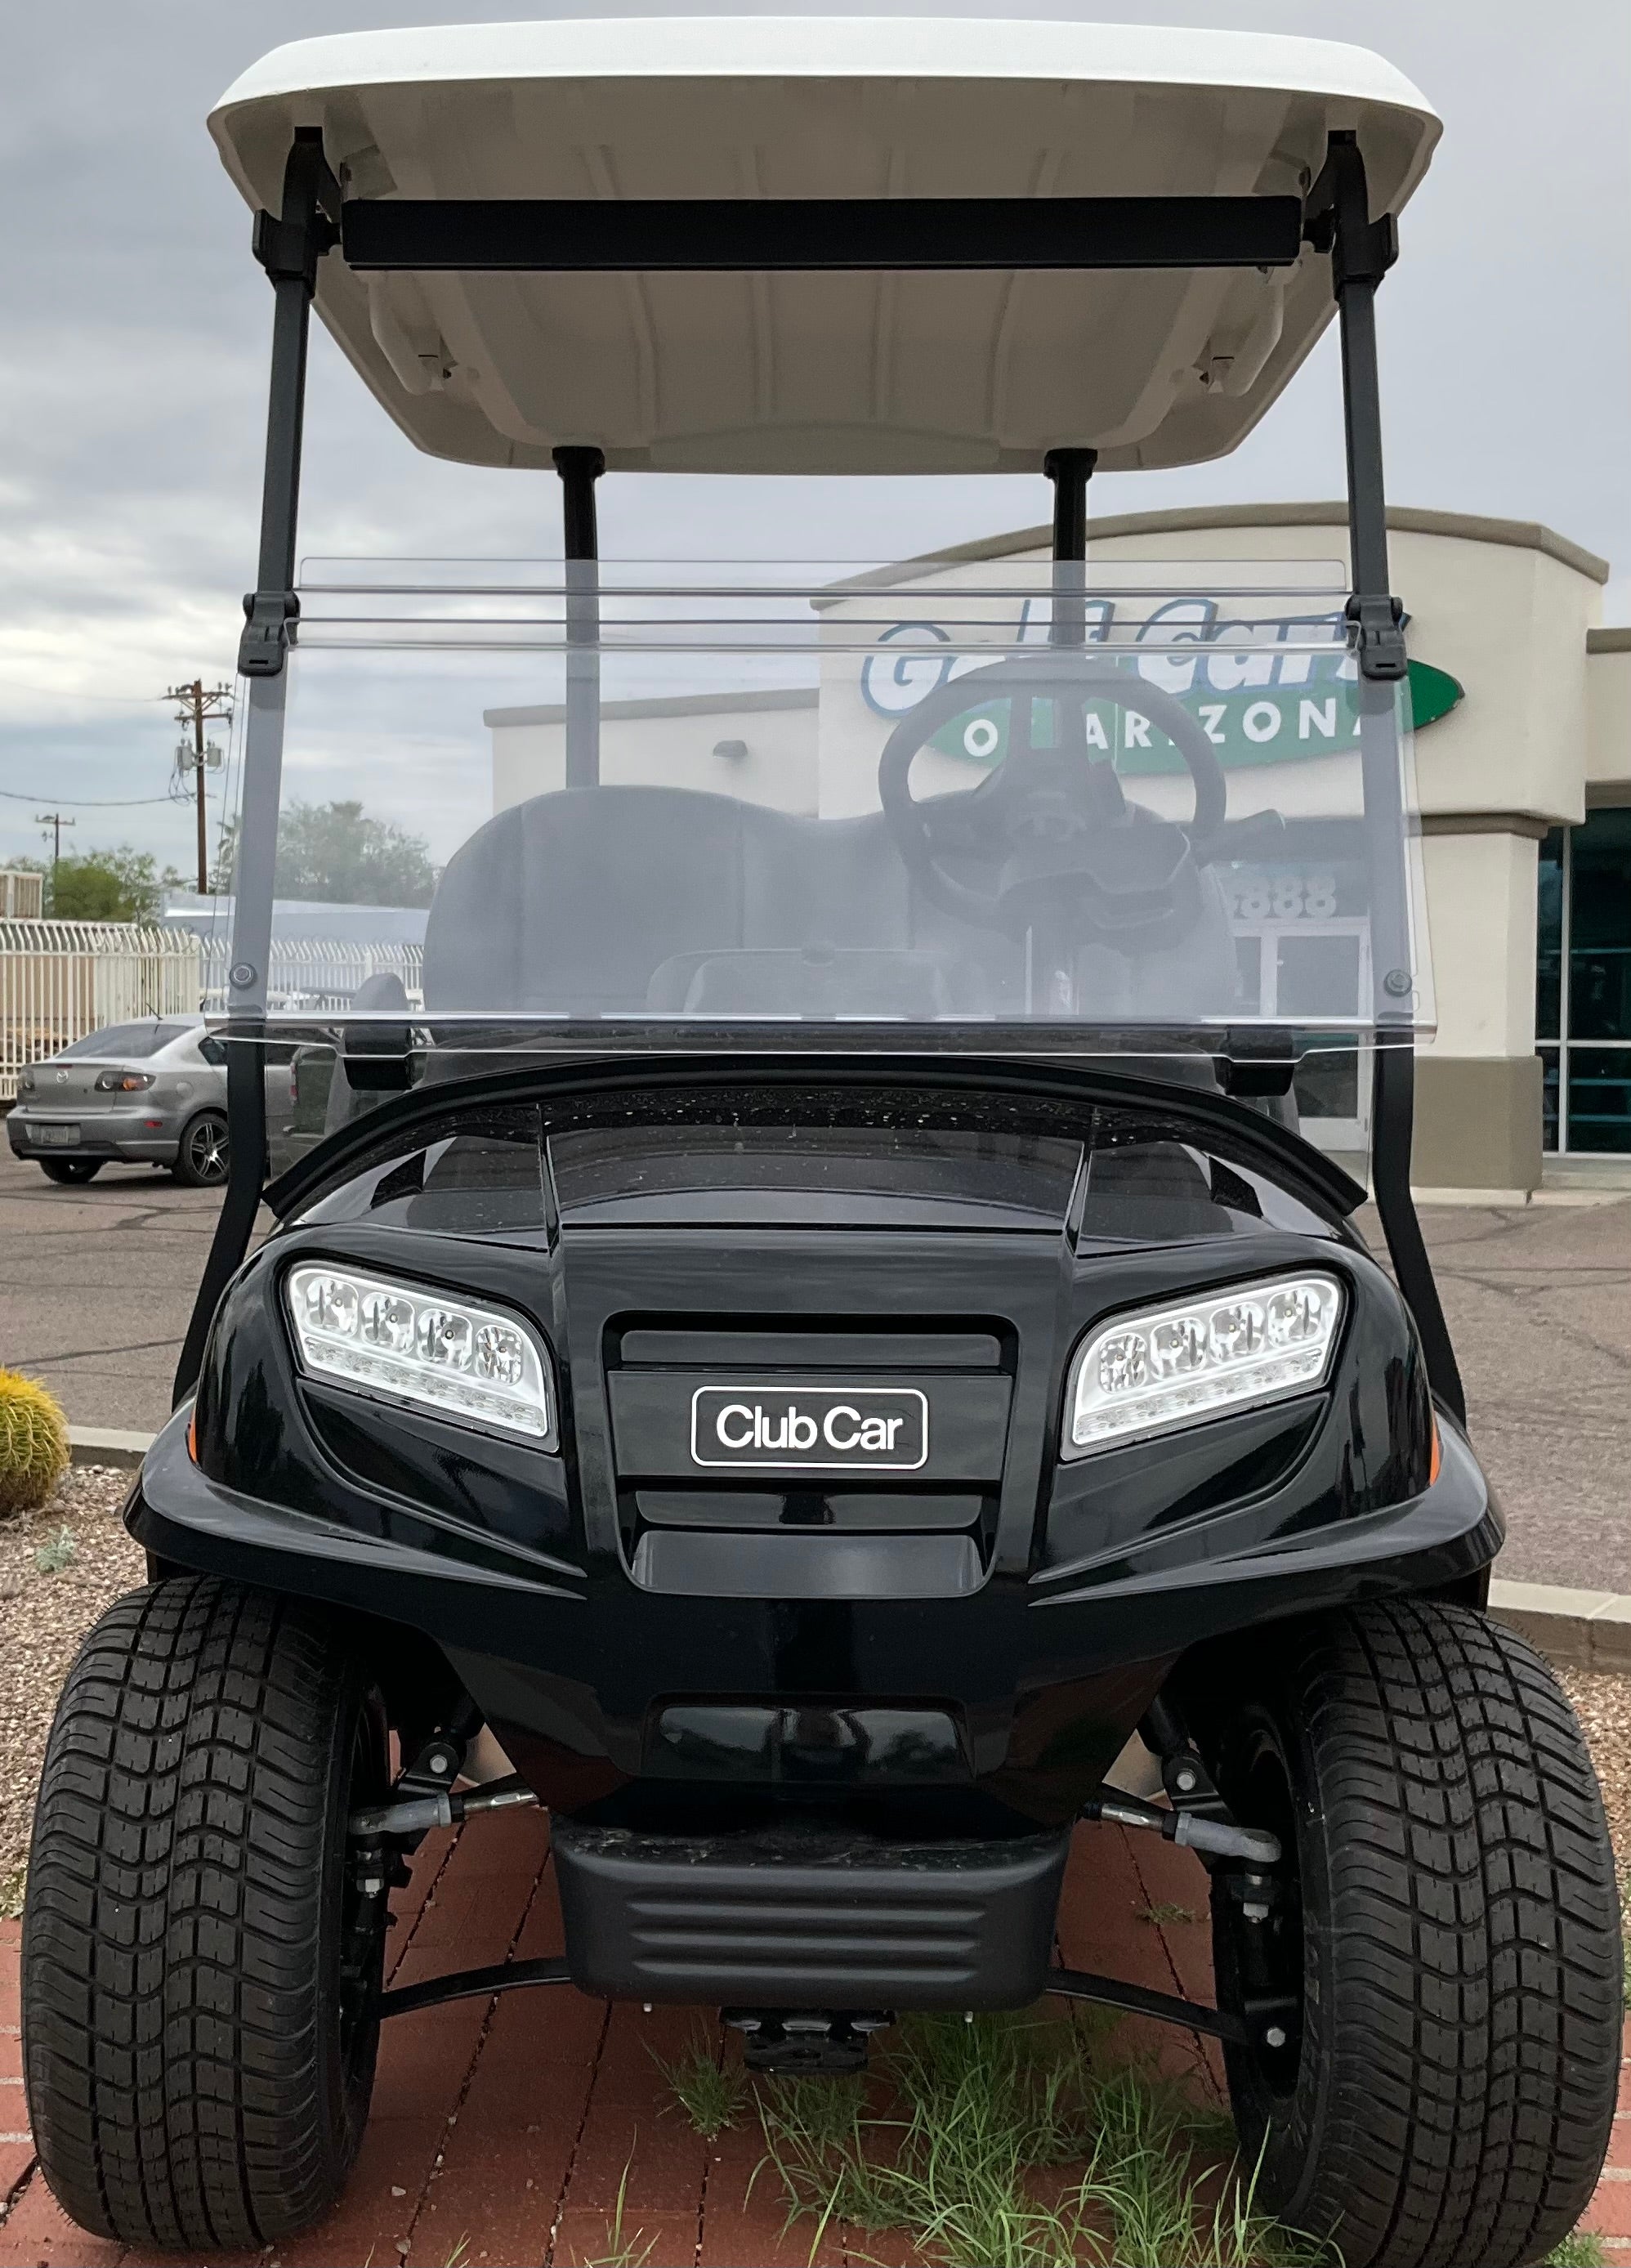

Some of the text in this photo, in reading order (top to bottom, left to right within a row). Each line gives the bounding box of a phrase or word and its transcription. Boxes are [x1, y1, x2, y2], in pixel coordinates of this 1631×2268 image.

[1134, 598, 1412, 698] Car
[1085, 698, 1362, 750] ARZON
[716, 1403, 903, 1451] Club Car
